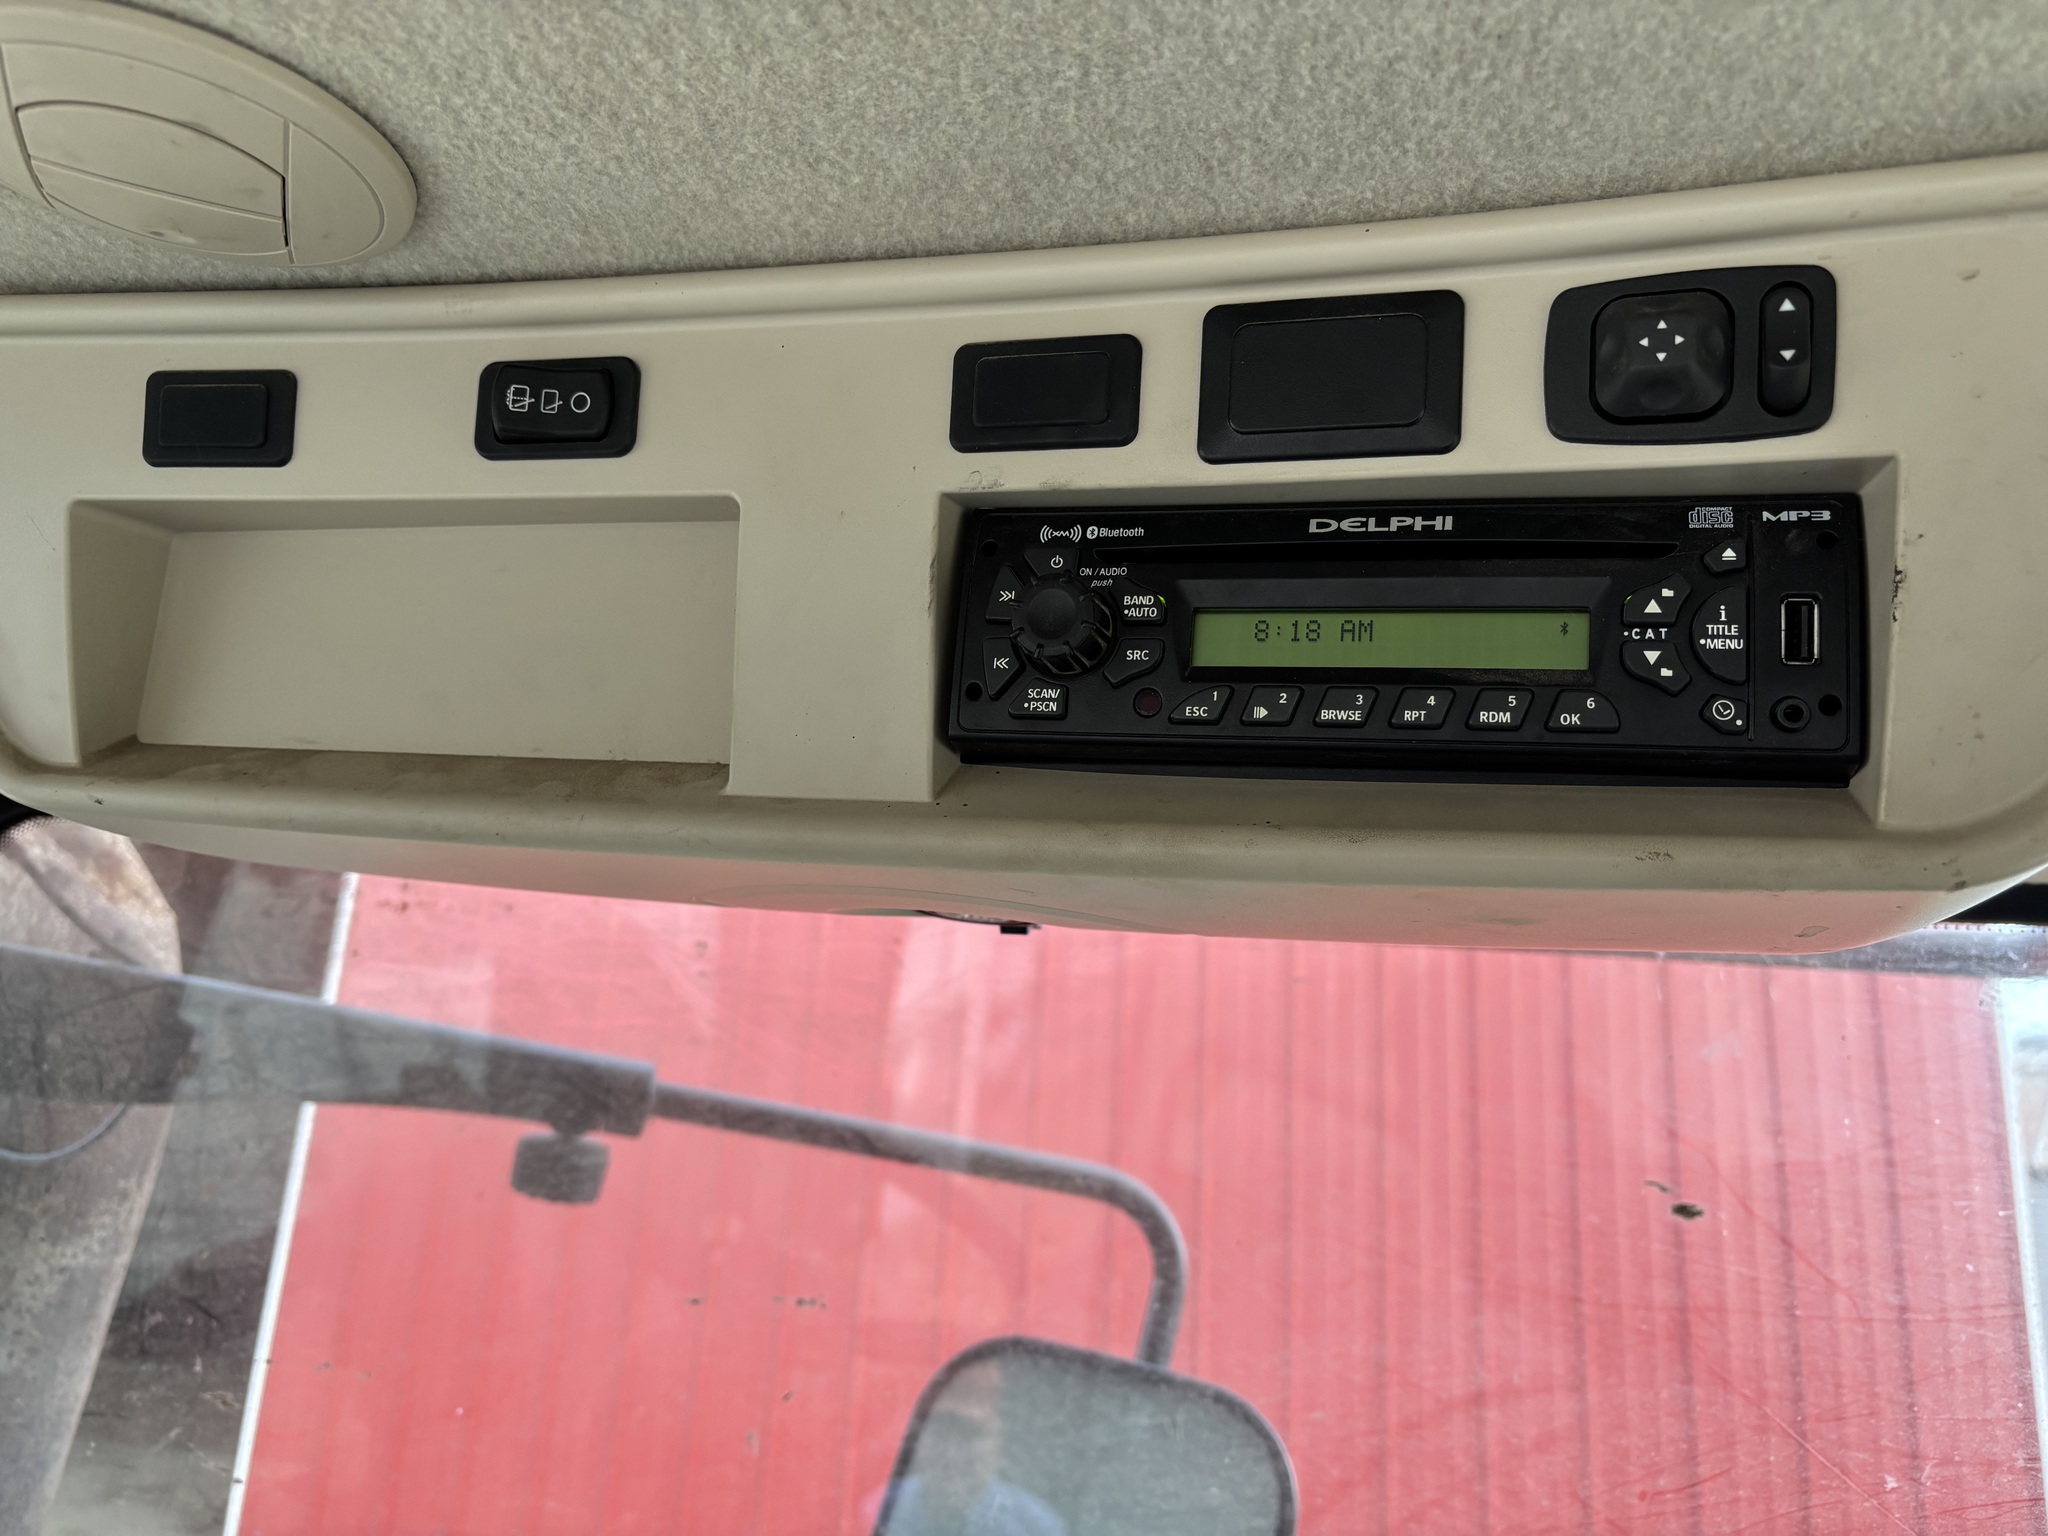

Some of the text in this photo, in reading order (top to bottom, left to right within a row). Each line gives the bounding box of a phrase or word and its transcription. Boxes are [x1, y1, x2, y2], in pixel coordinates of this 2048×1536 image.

[1762, 510, 1831, 522] MP3
[1308, 516, 1453, 533] DELPHI
[1099, 527, 1144, 537] Bluetooth
[1079, 567, 1092, 576] ON
[1099, 567, 1127, 576] AUDIO
[1090, 578, 1113, 588] push
[1123, 595, 1154, 605] BAND
[1253, 619, 1374, 642] 8:18 AM
[1706, 624, 1739, 636] TITLE
[1126, 650, 1149, 660] SRC
[1027, 688, 1060, 698] SCAN/
[1212, 691, 1218, 701] 1
[1279, 692, 1288, 704] 2
[1355, 694, 1363, 705] 3
[1427, 695, 1436, 707] 4
[1508, 695, 1516, 707] 5
[1586, 697, 1595, 710] 6
[1185, 706, 1209, 717] ESC
[1320, 709, 1362, 722] BRWSE
[1404, 710, 1427, 722] RPT
[1479, 711, 1511, 723] RDM
[1560, 713, 1581, 725] OK
